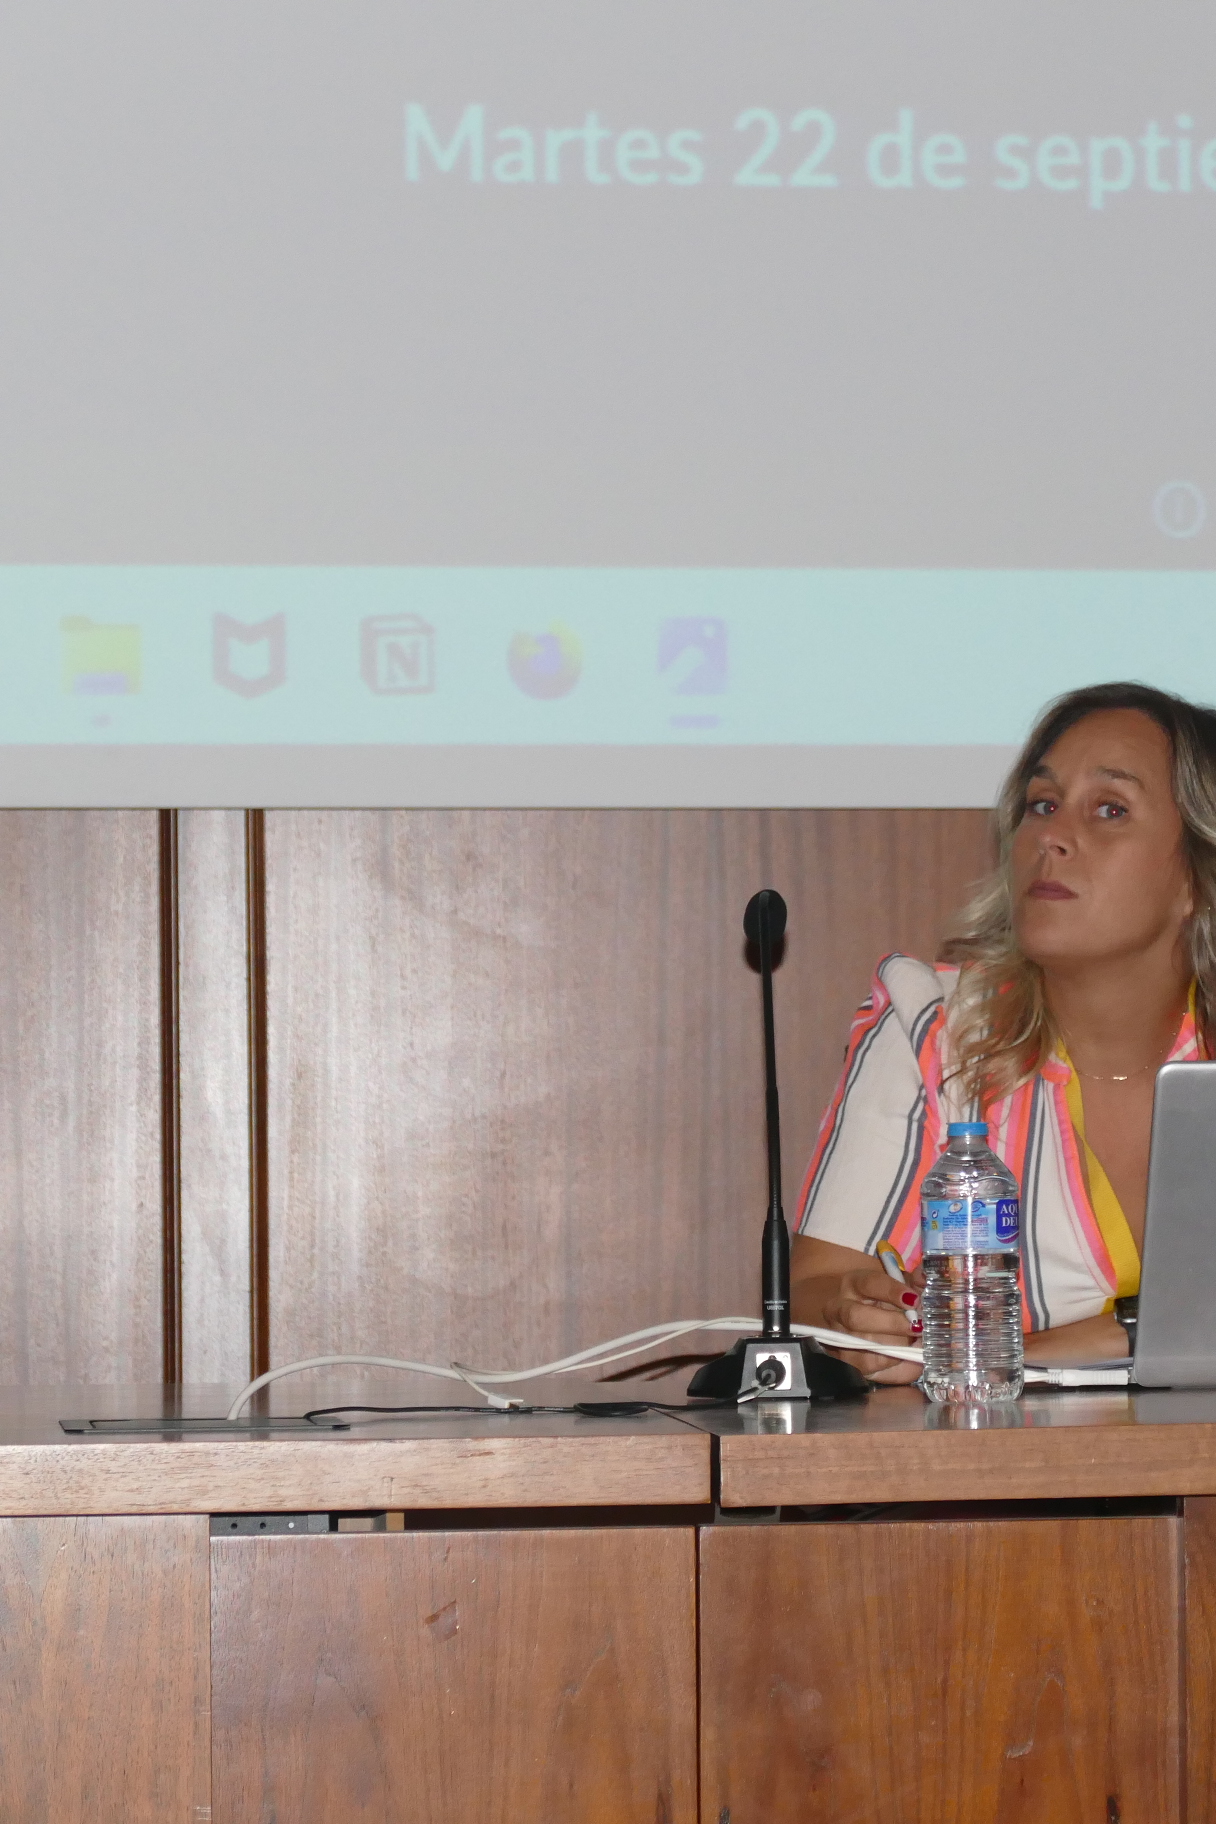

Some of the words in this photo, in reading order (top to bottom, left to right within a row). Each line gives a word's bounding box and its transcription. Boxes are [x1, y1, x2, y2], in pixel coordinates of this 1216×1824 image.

[404, 102, 706, 185] Martes
[732, 106, 840, 189] 22
[866, 106, 967, 190] de
